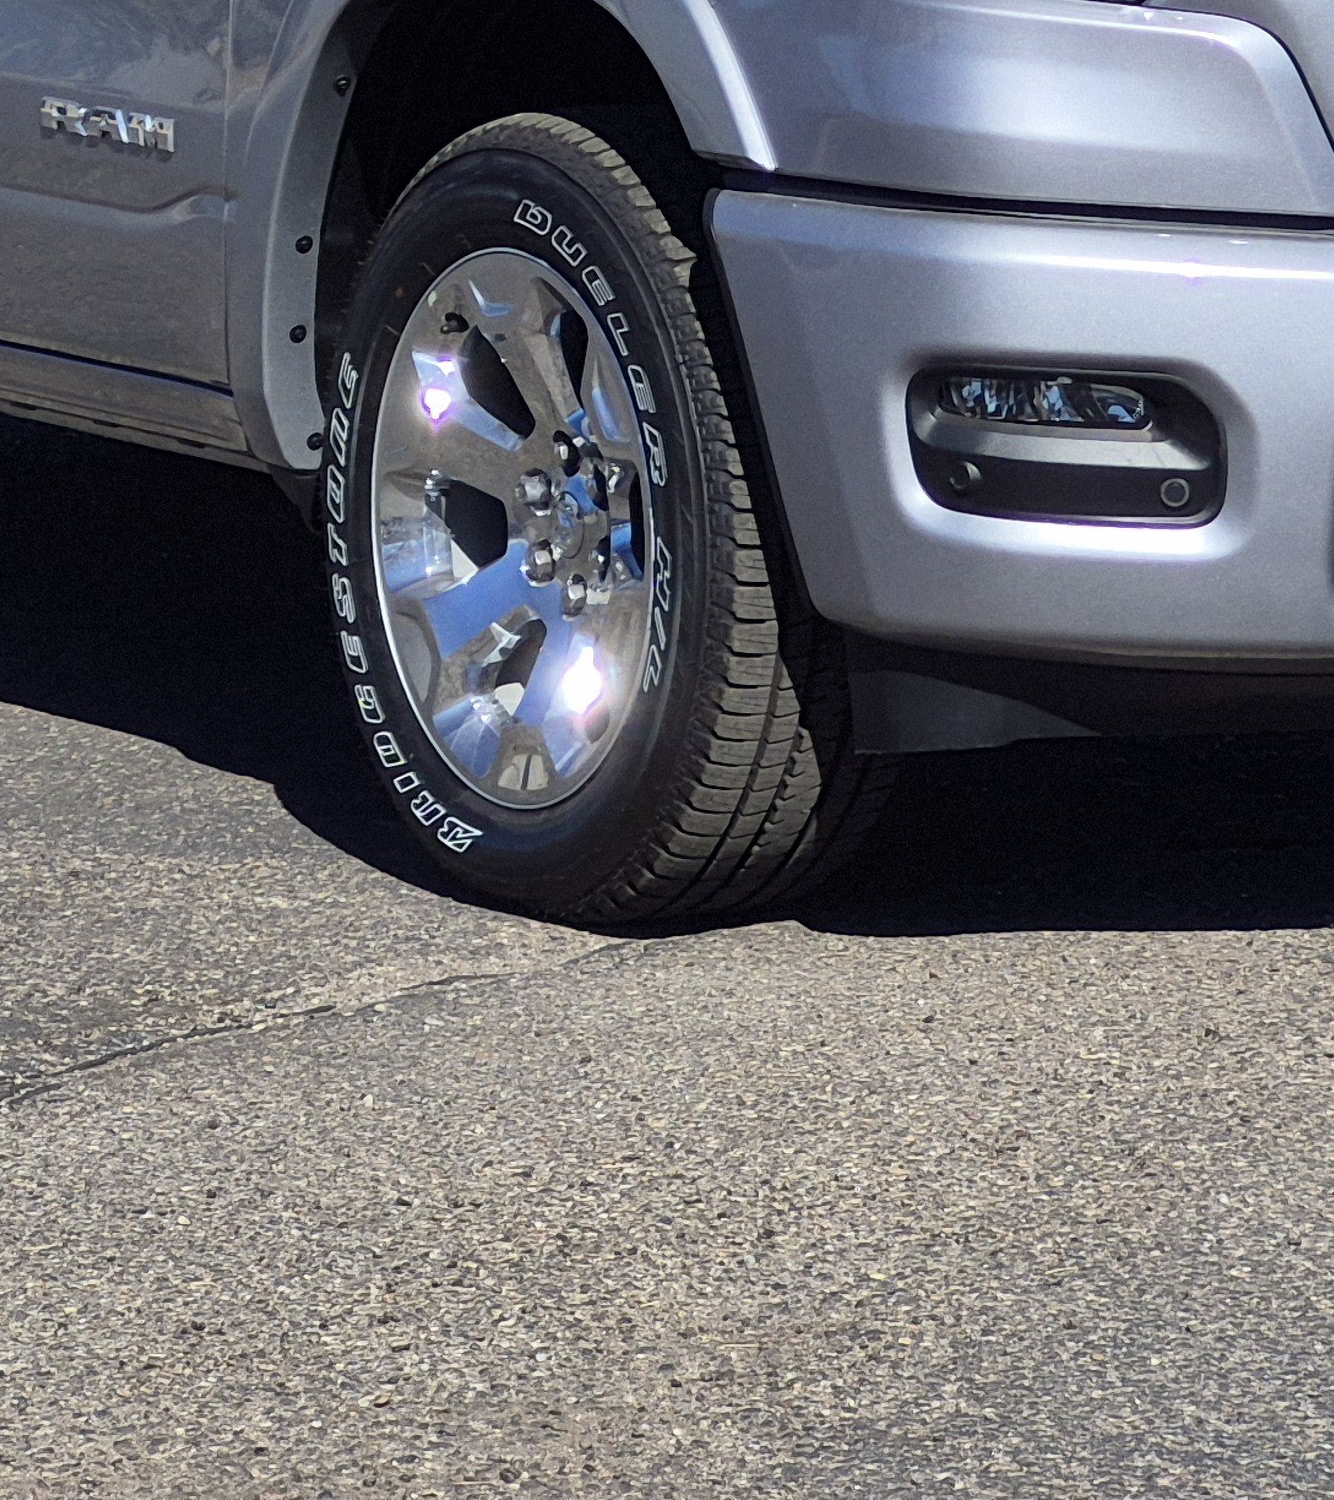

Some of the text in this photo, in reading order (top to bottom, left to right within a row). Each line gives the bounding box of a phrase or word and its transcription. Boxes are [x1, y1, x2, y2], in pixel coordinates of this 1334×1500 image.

[40, 96, 175, 153] RAM
[513, 199, 666, 487] DUELER
[327, 352, 483, 853] BRIDGESTONE
